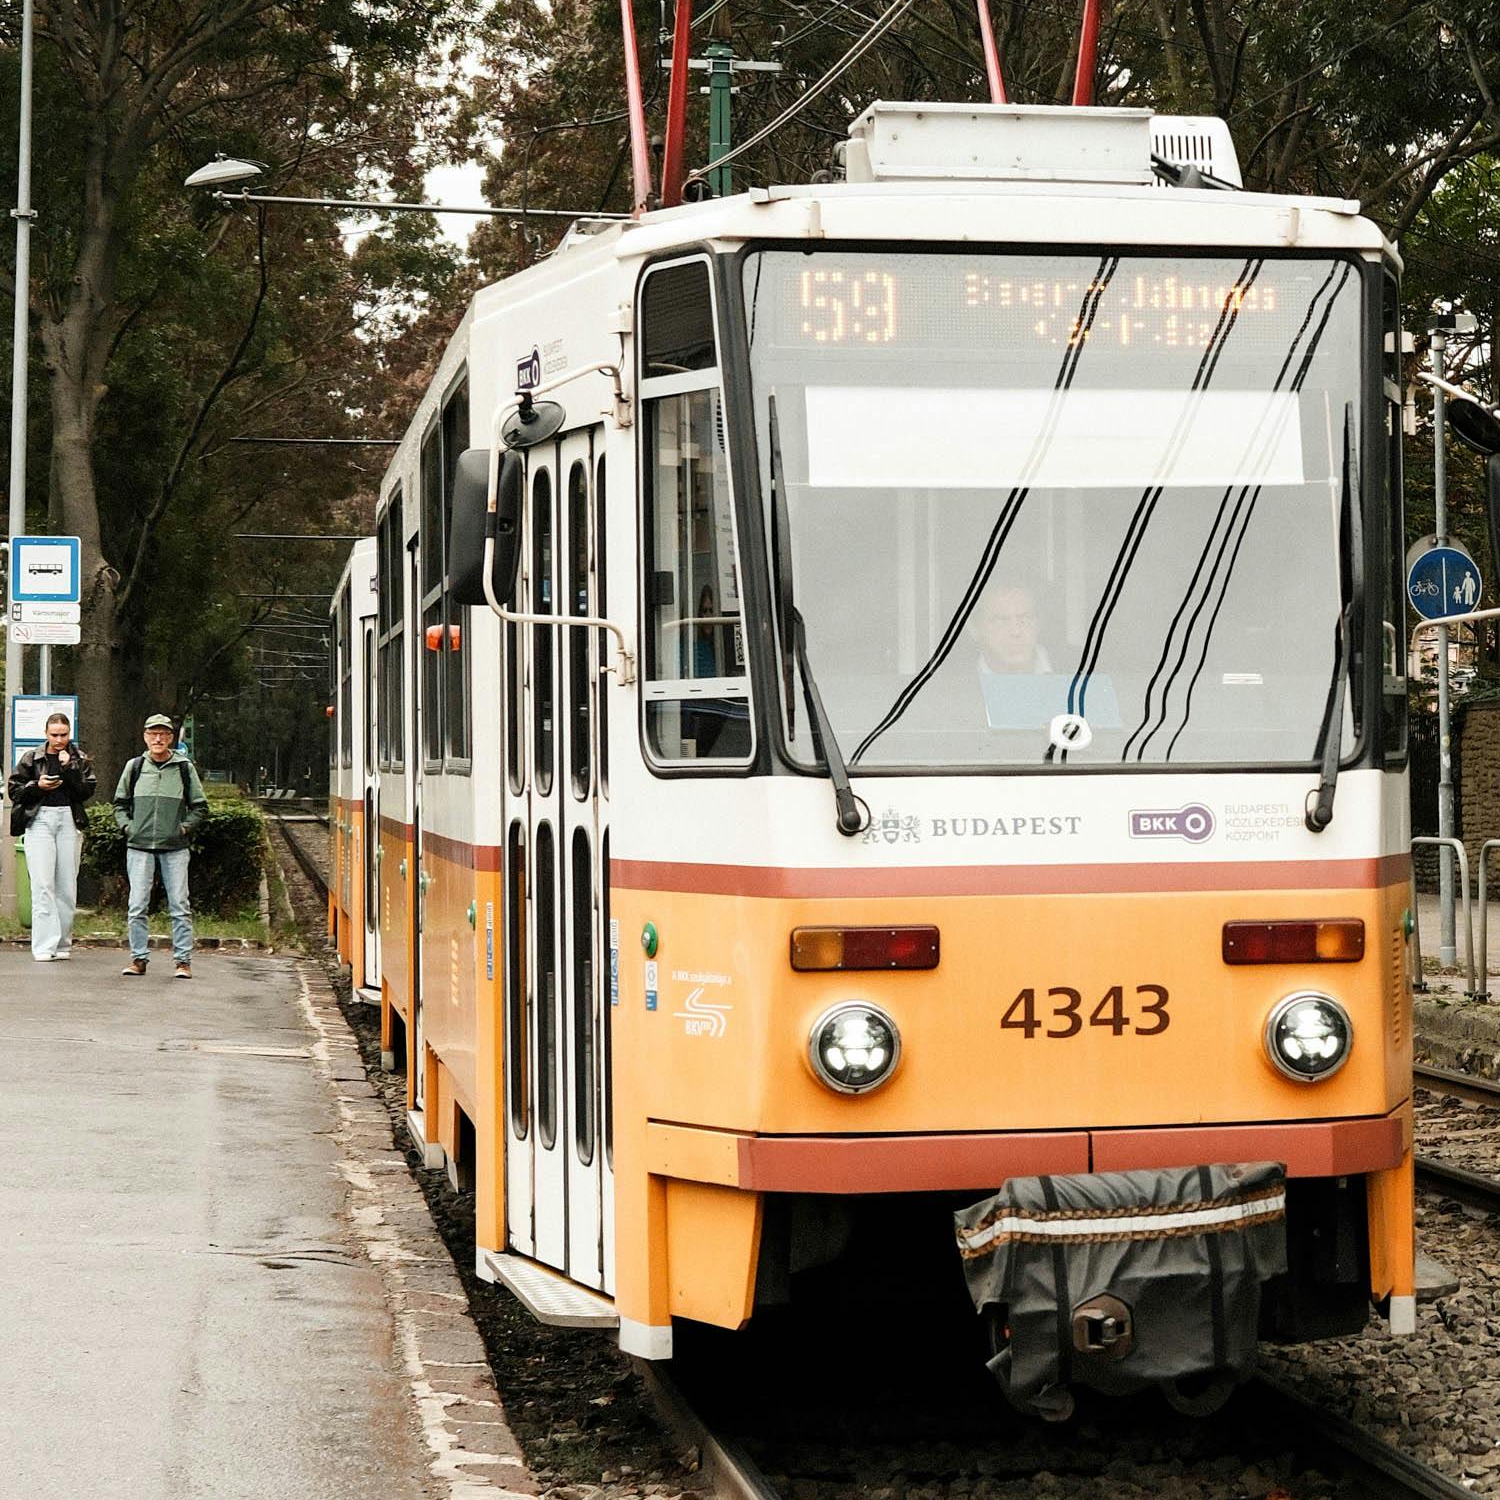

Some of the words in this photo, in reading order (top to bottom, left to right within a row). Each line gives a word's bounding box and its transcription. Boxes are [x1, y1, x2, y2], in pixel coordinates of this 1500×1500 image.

[800, 269, 898, 342] 59
[1224, 804, 1289, 814] BUDAPESTI
[931, 816, 1083, 838] BUDAPEST
[1138, 817, 1179, 832] BKK
[1000, 983, 1171, 1039] 4343
